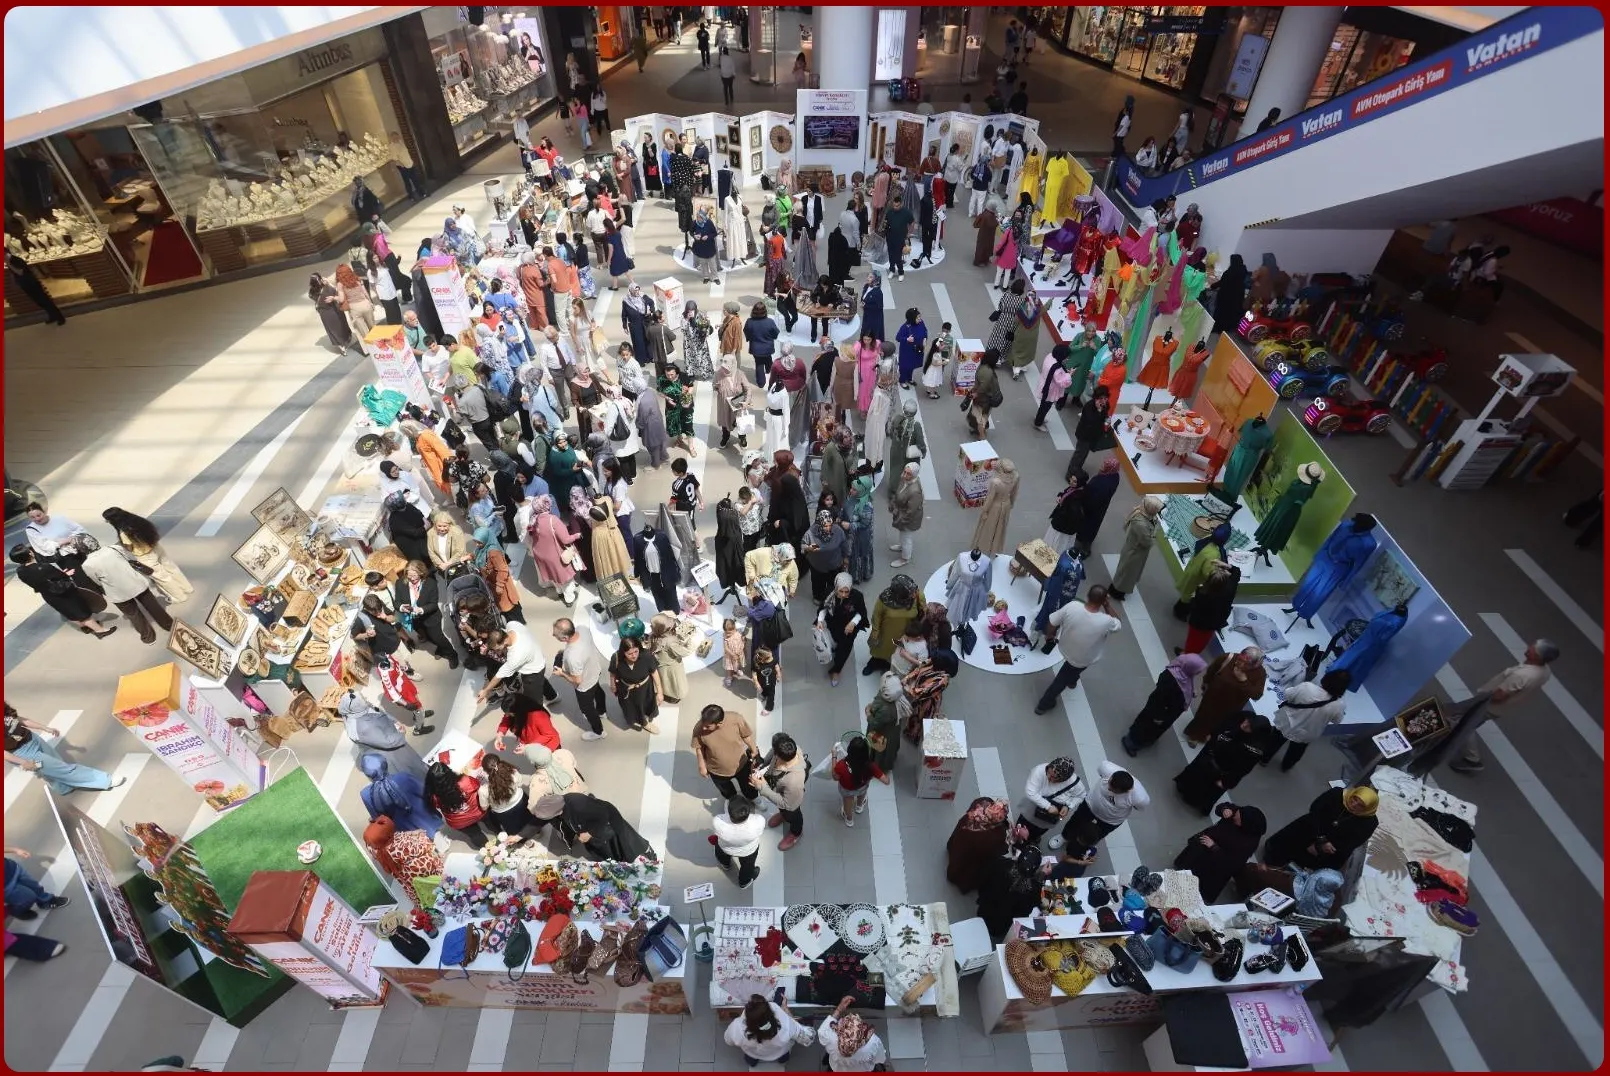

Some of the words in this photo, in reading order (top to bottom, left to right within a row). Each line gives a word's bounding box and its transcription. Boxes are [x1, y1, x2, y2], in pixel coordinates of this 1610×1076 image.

[1466, 22, 1542, 67] Vatan
[1355, 95, 1373, 114] AVM
[1373, 84, 1404, 106] Otopark
[1404, 76, 1425, 94] Giriş
[1301, 109, 1343, 135] Vatan
[1202, 157, 1229, 176] Vatan
[685, 483, 696, 502] 9
